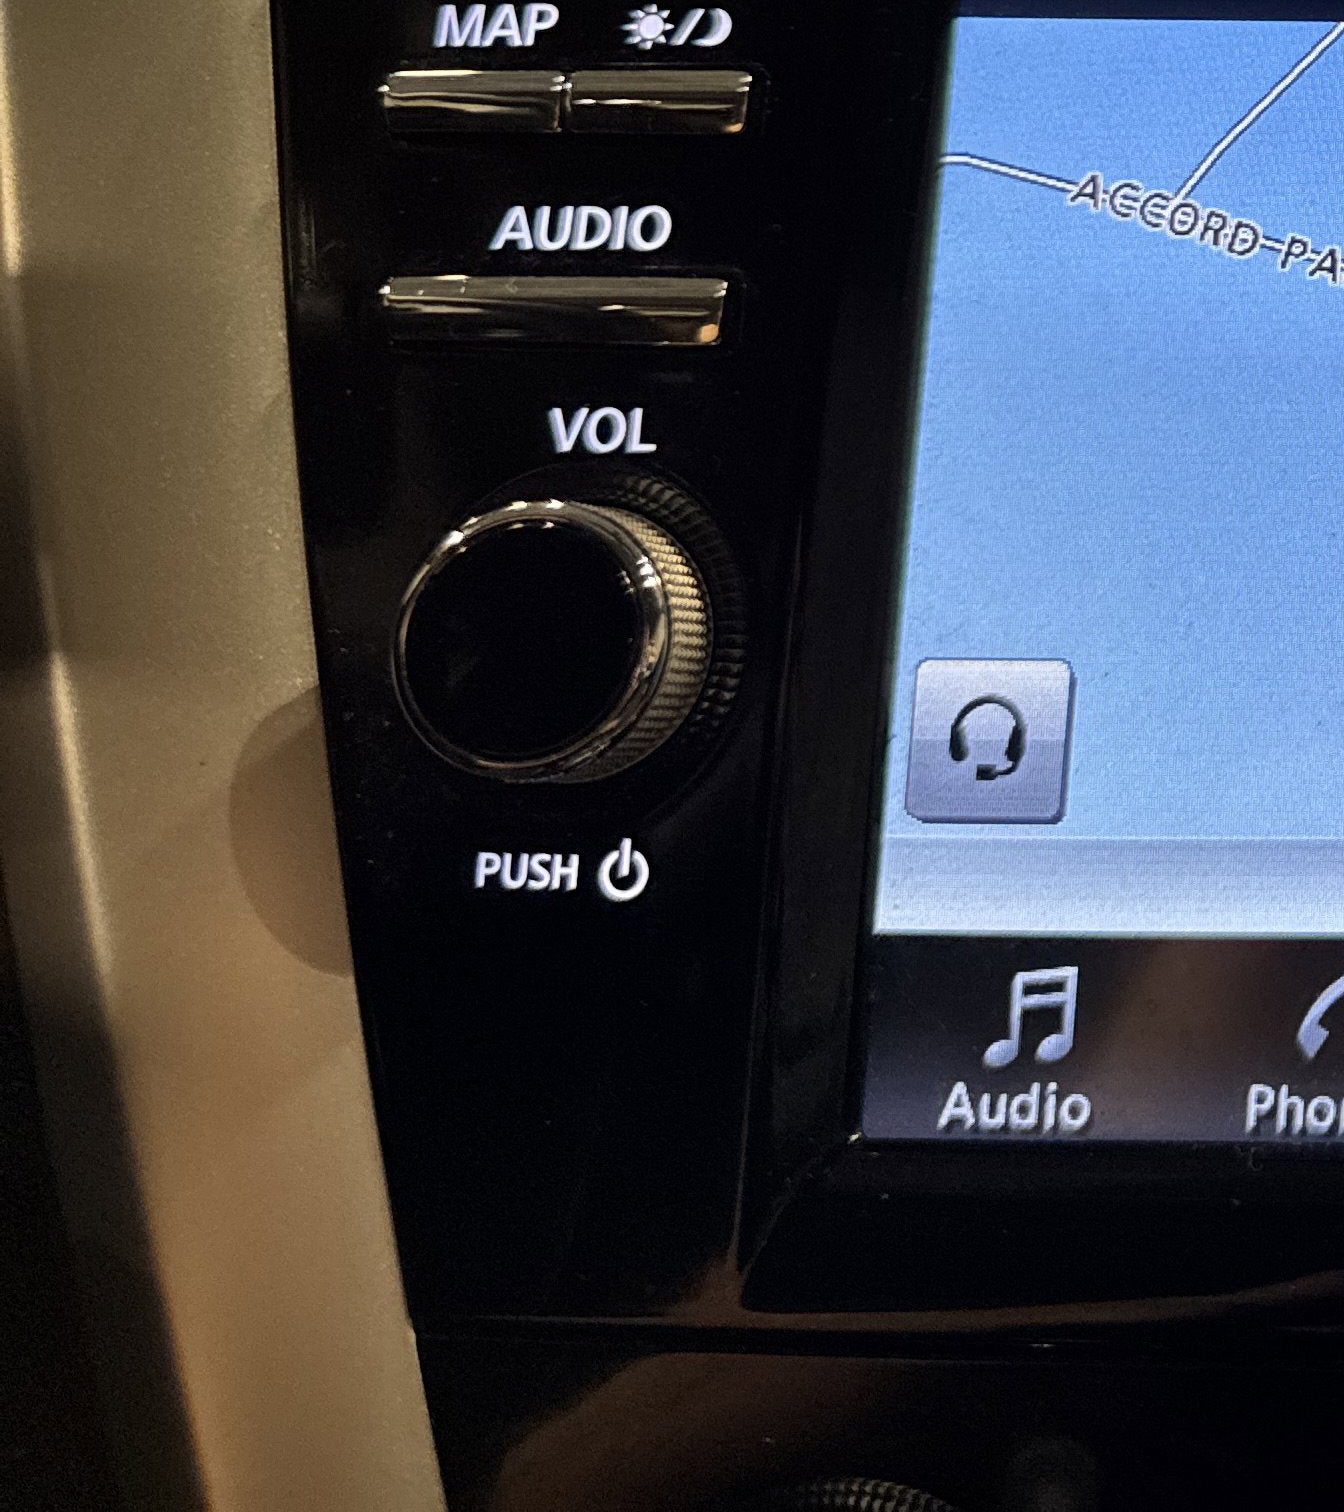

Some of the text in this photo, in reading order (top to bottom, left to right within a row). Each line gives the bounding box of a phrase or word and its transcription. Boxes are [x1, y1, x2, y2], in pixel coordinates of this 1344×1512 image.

[431, 1, 561, 49] MAP
[488, 203, 674, 253] AUDIO
[1070, 172, 1260, 257] ACCORD
[547, 405, 658, 455] VOL
[473, 850, 580, 892] PUSH
[936, 1081, 1092, 1133] Audio
